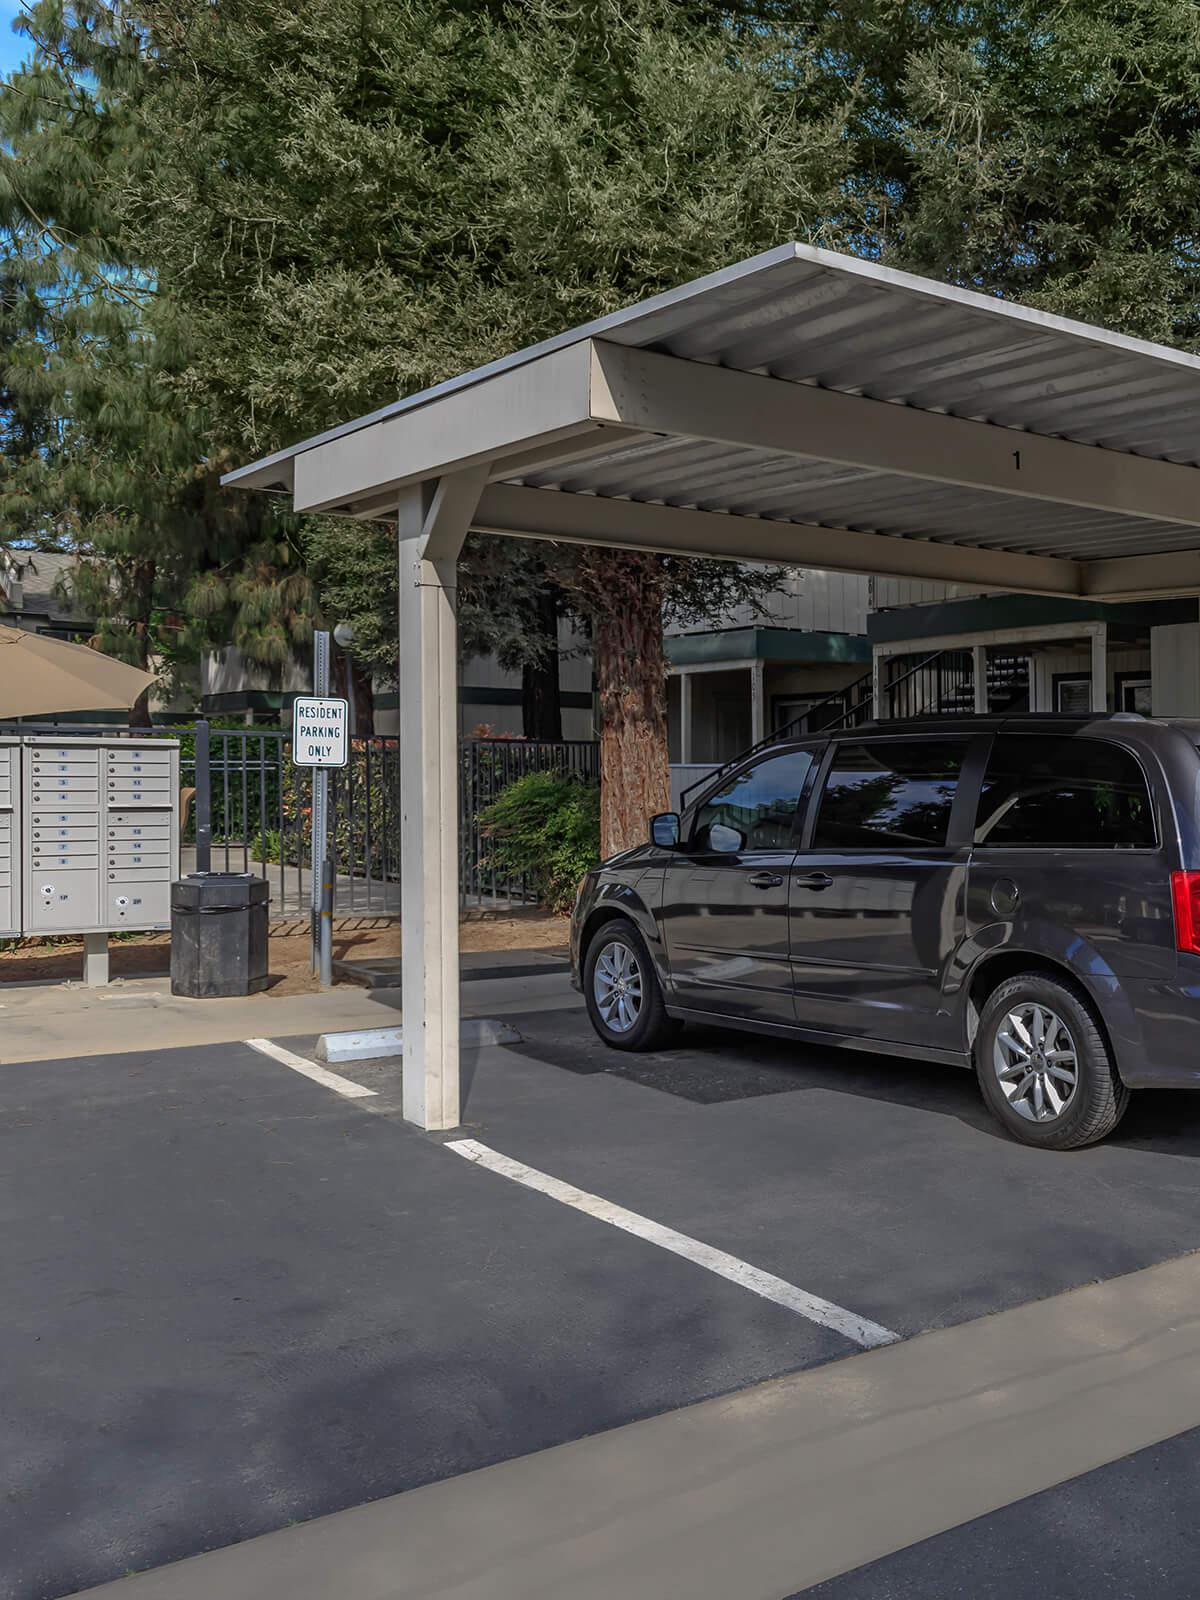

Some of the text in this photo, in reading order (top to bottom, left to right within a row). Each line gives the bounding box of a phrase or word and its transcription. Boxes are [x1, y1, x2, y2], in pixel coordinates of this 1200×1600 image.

[1012, 450, 1020, 470] 1
[299, 706, 342, 719] RESIDENT
[300, 726, 340, 738] PARKING
[308, 745, 332, 757] ONLY
